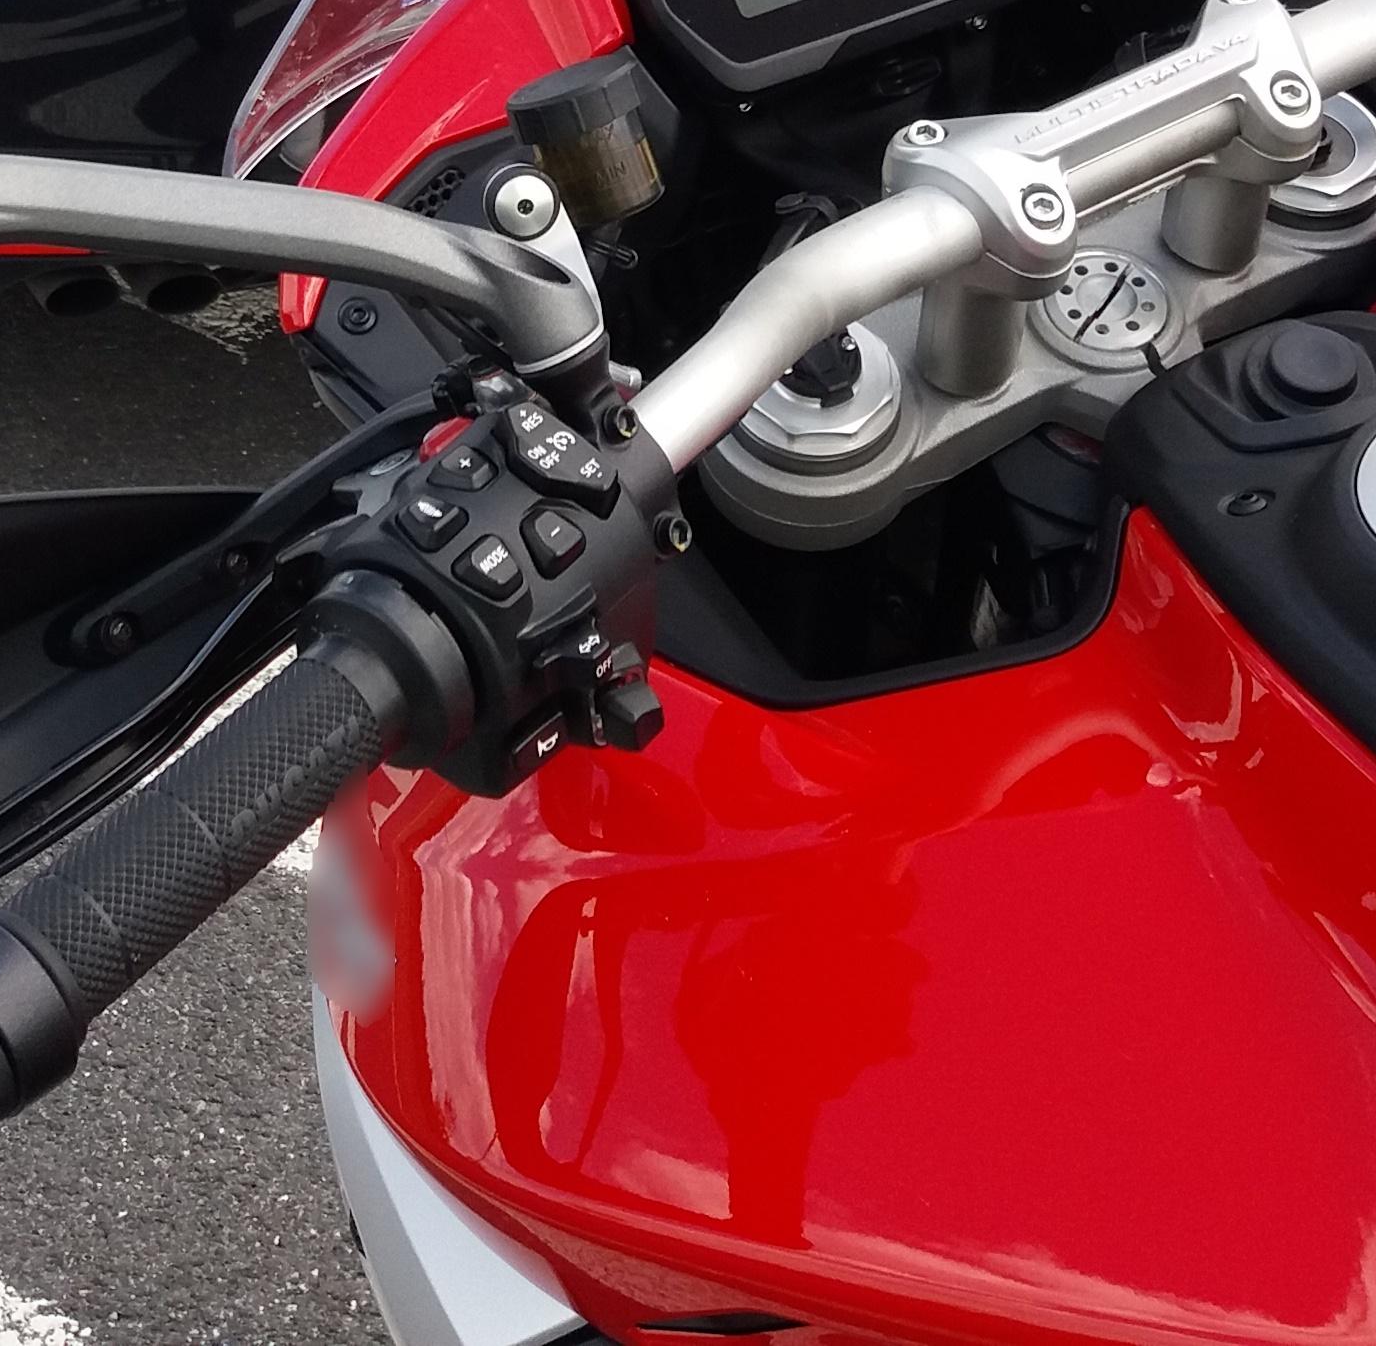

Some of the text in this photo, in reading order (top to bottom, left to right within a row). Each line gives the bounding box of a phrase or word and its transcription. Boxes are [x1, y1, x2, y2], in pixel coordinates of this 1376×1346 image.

[521, 411, 544, 433] RES
[527, 444, 547, 460] ON
[539, 449, 561, 470] OFF
[579, 457, 601, 479] SET
[479, 544, 509, 574] MODE
[596, 655, 612, 678] OFF
